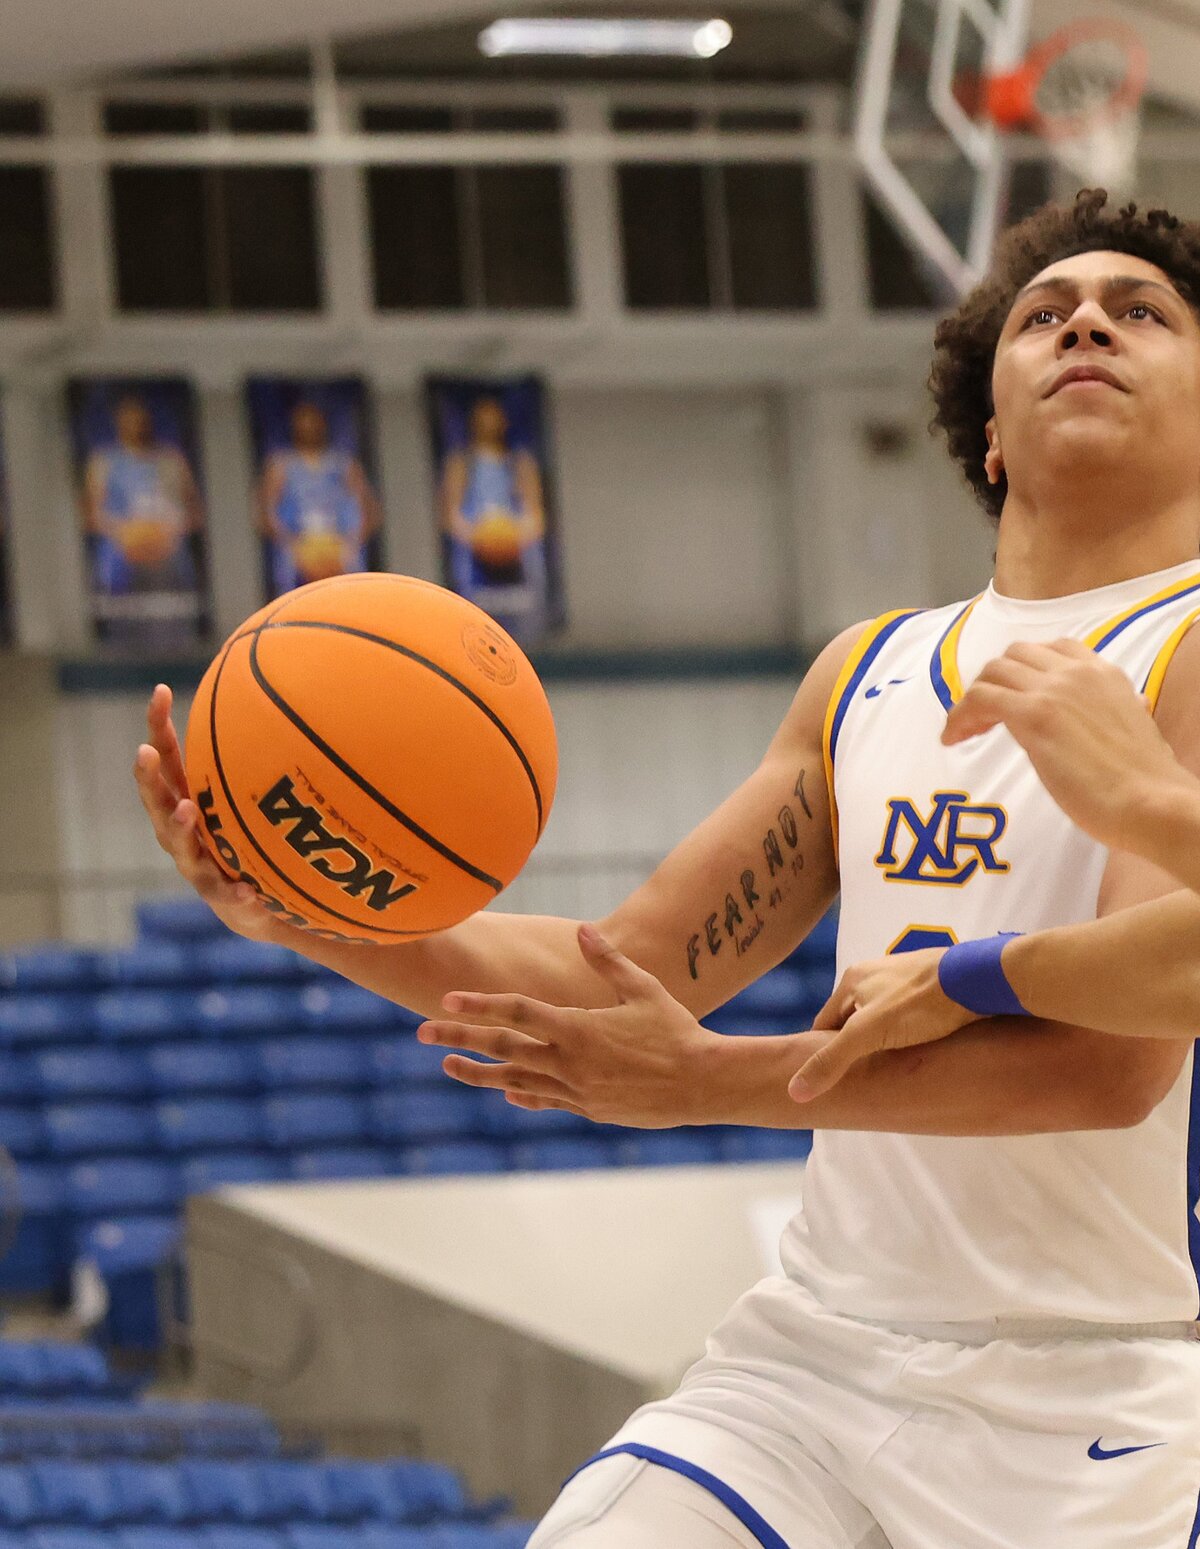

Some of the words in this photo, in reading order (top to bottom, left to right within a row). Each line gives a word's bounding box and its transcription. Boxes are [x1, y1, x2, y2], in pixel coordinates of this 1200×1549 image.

[257, 773, 419, 912] NCAA
[686, 868, 760, 980] FEAR
[762, 768, 813, 878] NOT
